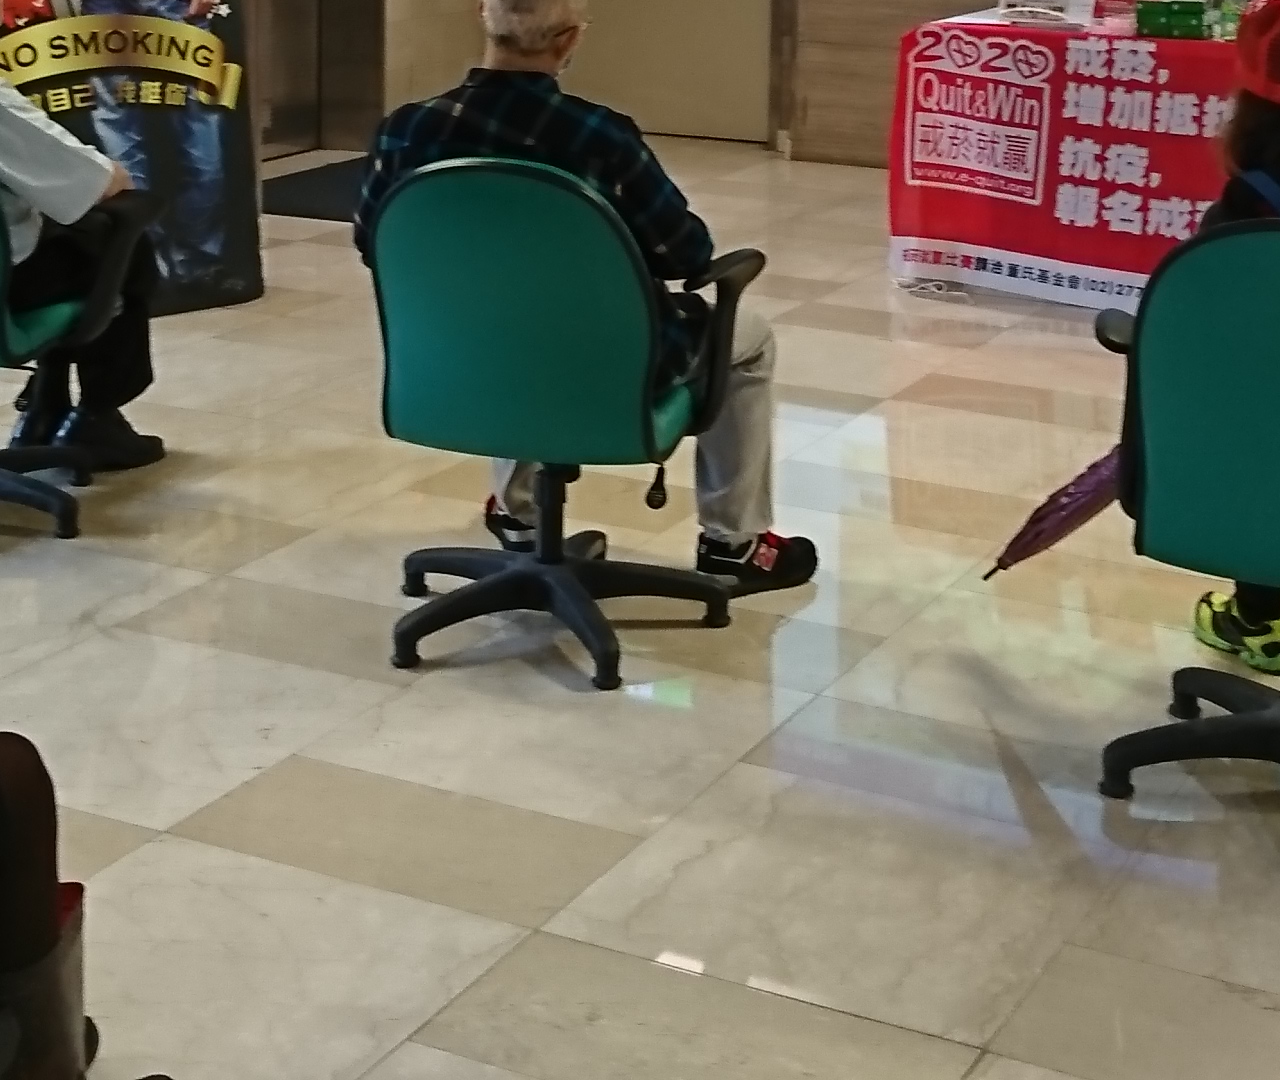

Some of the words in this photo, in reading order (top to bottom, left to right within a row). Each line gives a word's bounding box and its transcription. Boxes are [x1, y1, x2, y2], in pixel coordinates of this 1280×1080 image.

[50, 29, 215, 69] SMOKING
[917, 72, 1040, 127] Quit&Win
[919, 119, 1033, 175] 戒菸就贏
